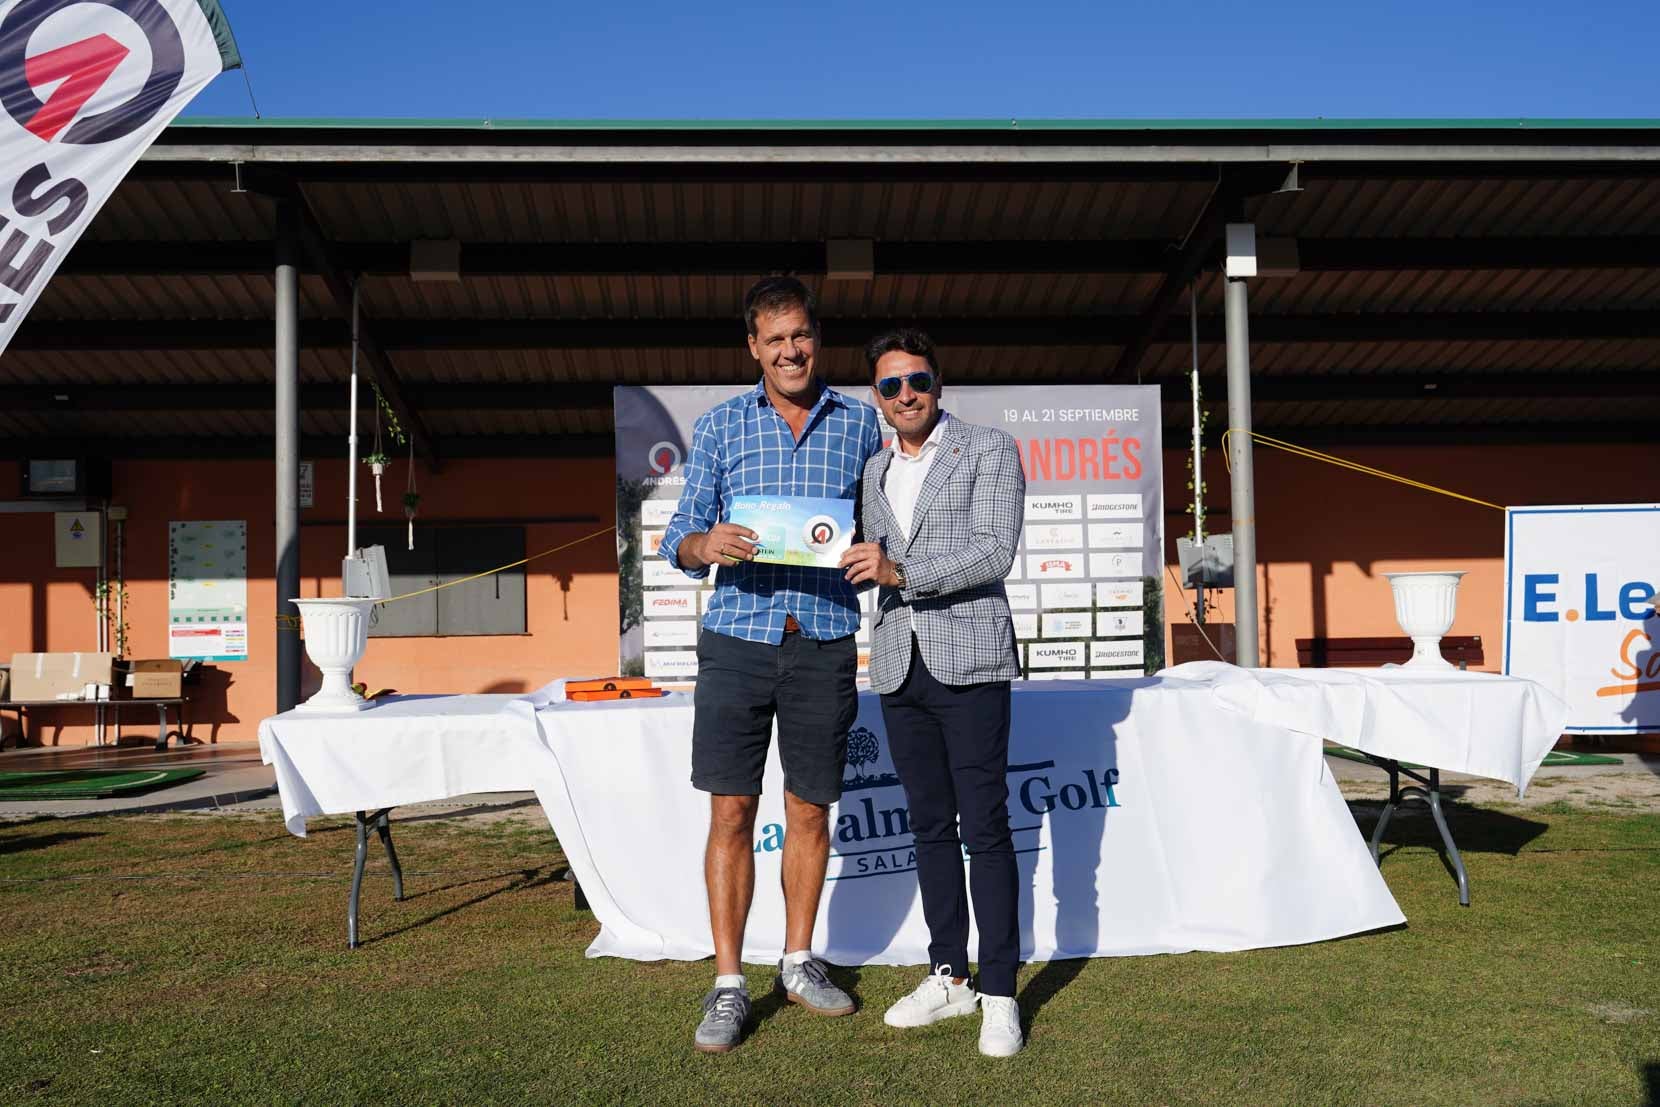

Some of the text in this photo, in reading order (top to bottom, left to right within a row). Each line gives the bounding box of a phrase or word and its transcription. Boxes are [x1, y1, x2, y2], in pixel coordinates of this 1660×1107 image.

[1003, 408, 1140, 422] 19 AL 21 SEPTIEMBRE
[759, 500, 792, 512] Regalo
[1091, 503, 1138, 511] BRIDGESTONE
[653, 598, 688, 607] FEDIMA
[1095, 650, 1140, 658] BRIDGESTONE
[1019, 767, 1121, 817] Golf
